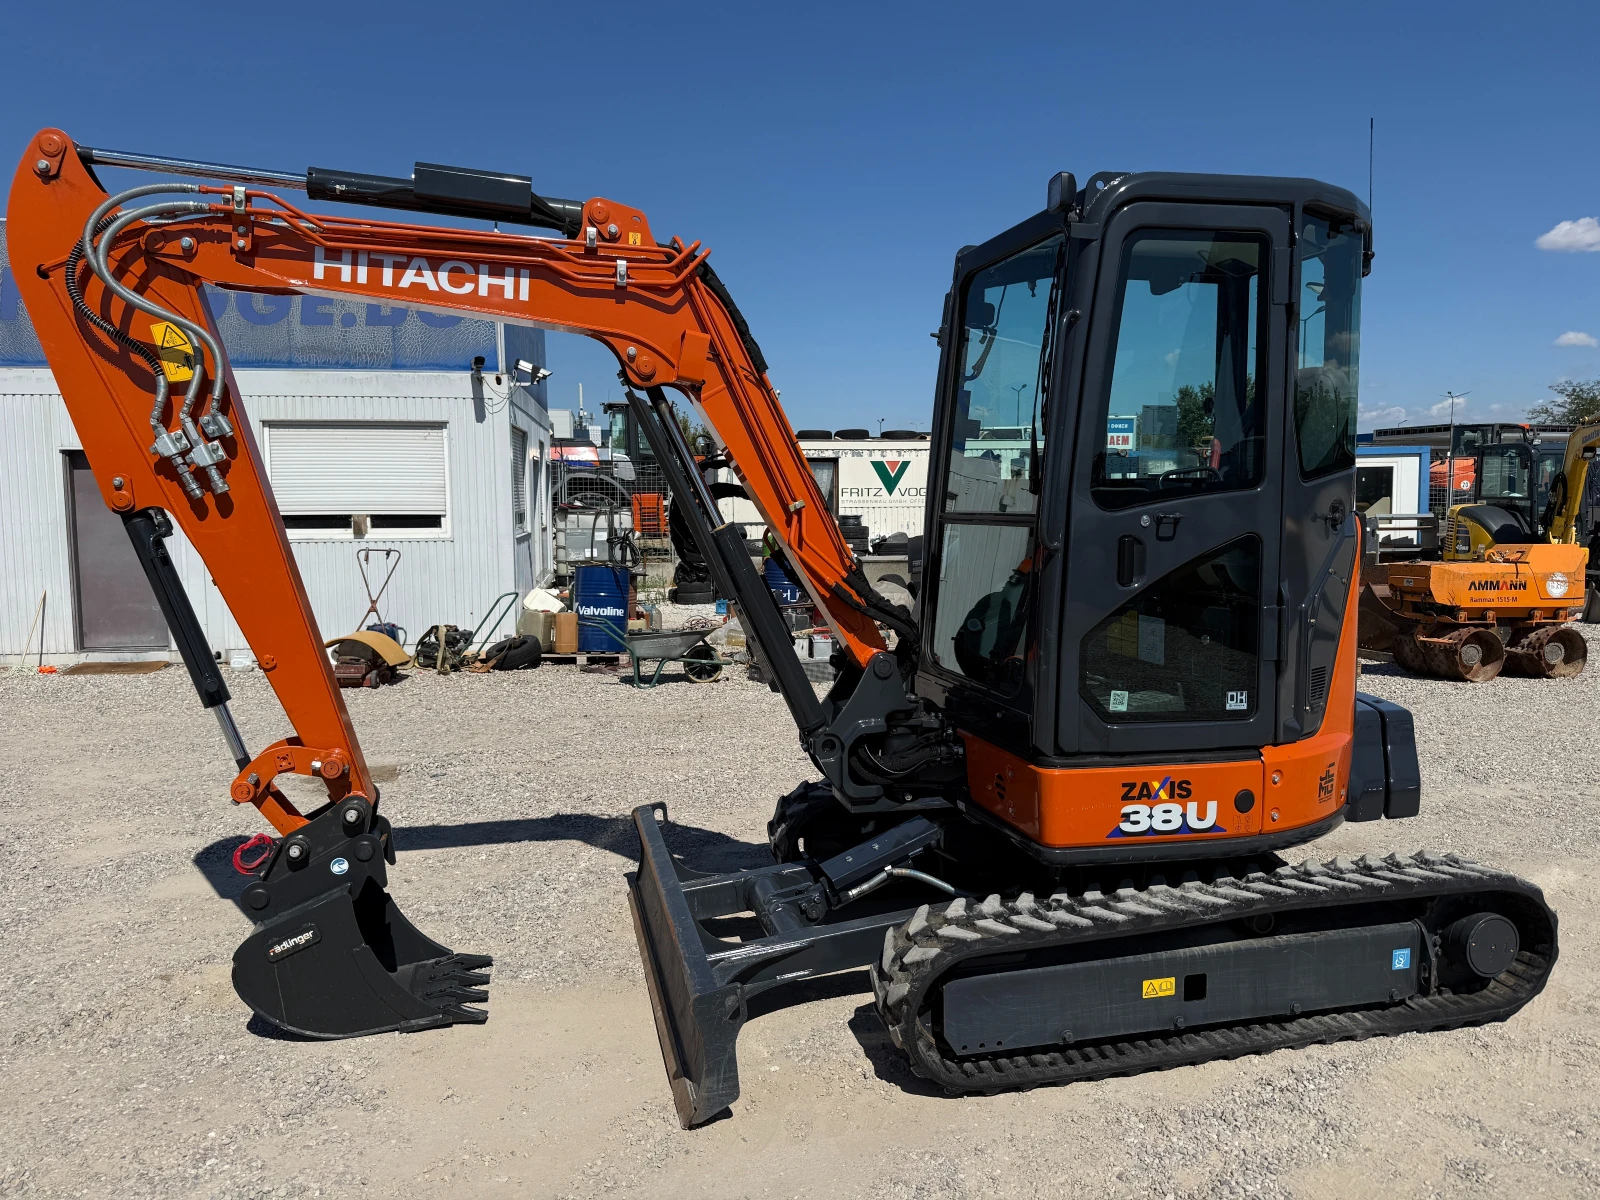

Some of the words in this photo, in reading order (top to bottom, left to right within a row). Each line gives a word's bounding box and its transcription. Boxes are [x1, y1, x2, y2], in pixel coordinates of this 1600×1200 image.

[314, 246, 530, 301] HITACHI
[1109, 435, 1129, 446] АЕМ
[841, 487, 883, 497] FRITZ
[898, 487, 926, 497] VOG
[1468, 579, 1527, 590] AMMANN
[578, 605, 625, 617] Valvoline
[1120, 776, 1193, 802] ZAXIS
[1118, 801, 1218, 836] 38U
[268, 930, 314, 956] rädlinger
